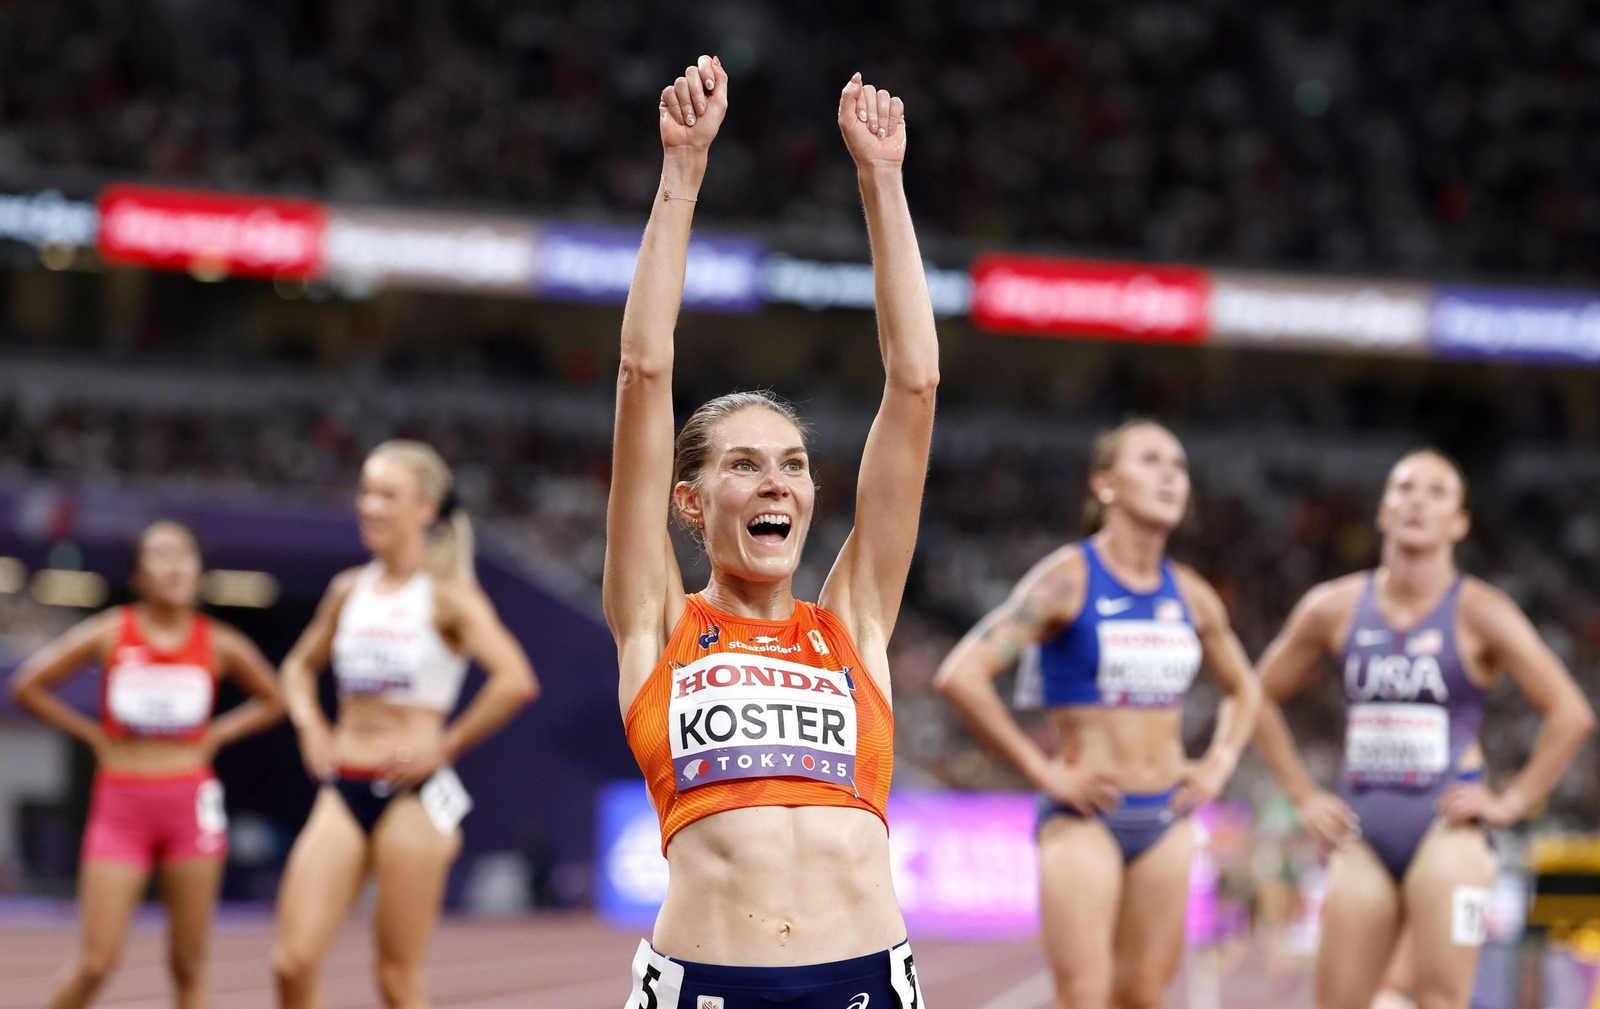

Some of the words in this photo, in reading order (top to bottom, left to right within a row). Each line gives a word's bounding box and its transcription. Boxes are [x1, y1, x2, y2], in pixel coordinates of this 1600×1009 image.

[675, 664, 848, 698] HONDA
[1344, 654, 1450, 702] USA
[680, 703, 846, 749] KOSTER
[639, 963, 662, 1009] 5
